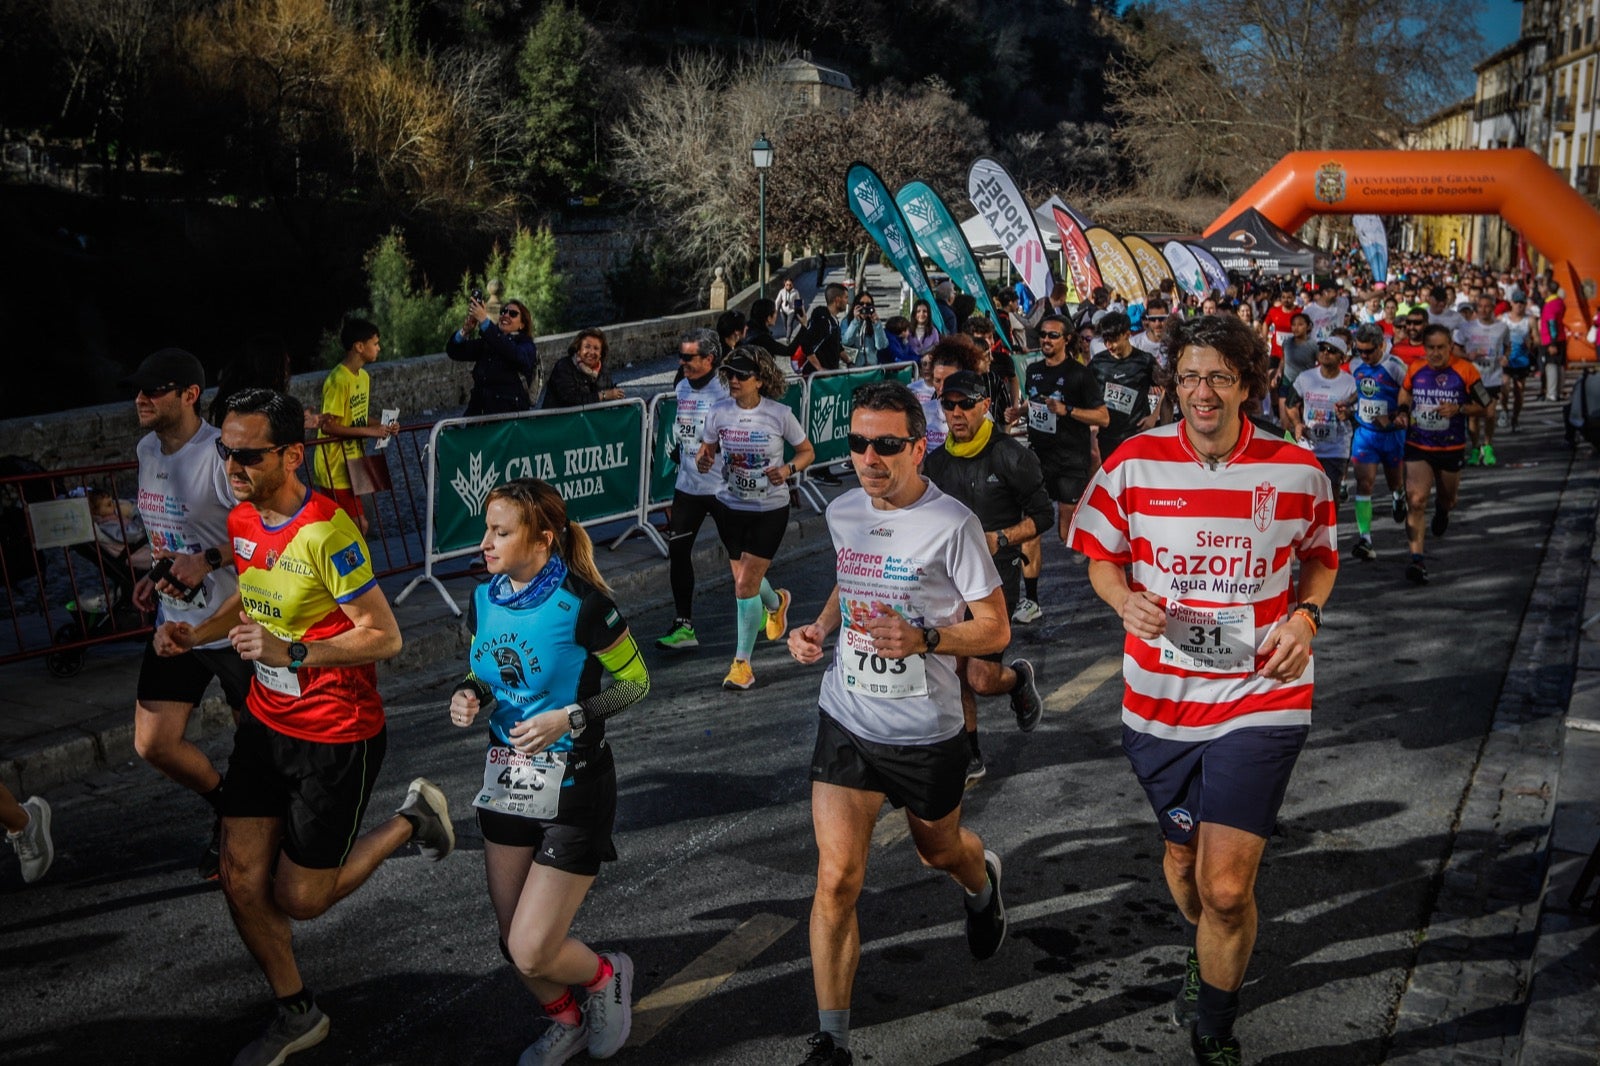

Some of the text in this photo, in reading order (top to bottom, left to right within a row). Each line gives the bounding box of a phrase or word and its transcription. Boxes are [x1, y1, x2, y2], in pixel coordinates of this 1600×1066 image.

[1446, 174, 1497, 184] GRANADA
[1420, 186, 1434, 195] de
[1437, 185, 1484, 196] Deportes
[1106, 389, 1132, 404] 2373
[1032, 410, 1048, 422] 248
[1362, 406, 1380, 415] 482
[680, 424, 696, 434] 291
[505, 442, 628, 483] CAJA RURAL
[553, 476, 605, 501] ANADA
[736, 476, 756, 488] 308
[140, 489, 164, 502] Carrera
[1196, 531, 1252, 550] Sierra
[844, 548, 883, 564] Carrera
[886, 556, 902, 564] Ave
[1156, 547, 1267, 578] Cazorla
[840, 560, 883, 578] Solidaria
[882, 572, 919, 582] Granada
[1170, 578, 1206, 594] Agua
[272, 592, 282, 601] de
[244, 597, 282, 619] spaña
[1169, 602, 1178, 618] 9
[1178, 606, 1214, 618] Carrera
[1176, 612, 1218, 626] Solidaria
[847, 632, 874, 646] 9 Carre
[1189, 626, 1222, 646] 31
[854, 642, 877, 653] Solidar
[1180, 644, 1204, 653] MIGUEL
[854, 650, 907, 674] 703
[490, 748, 498, 764] 9
[497, 766, 547, 792] 425
[614, 972, 622, 1004] HOKA
